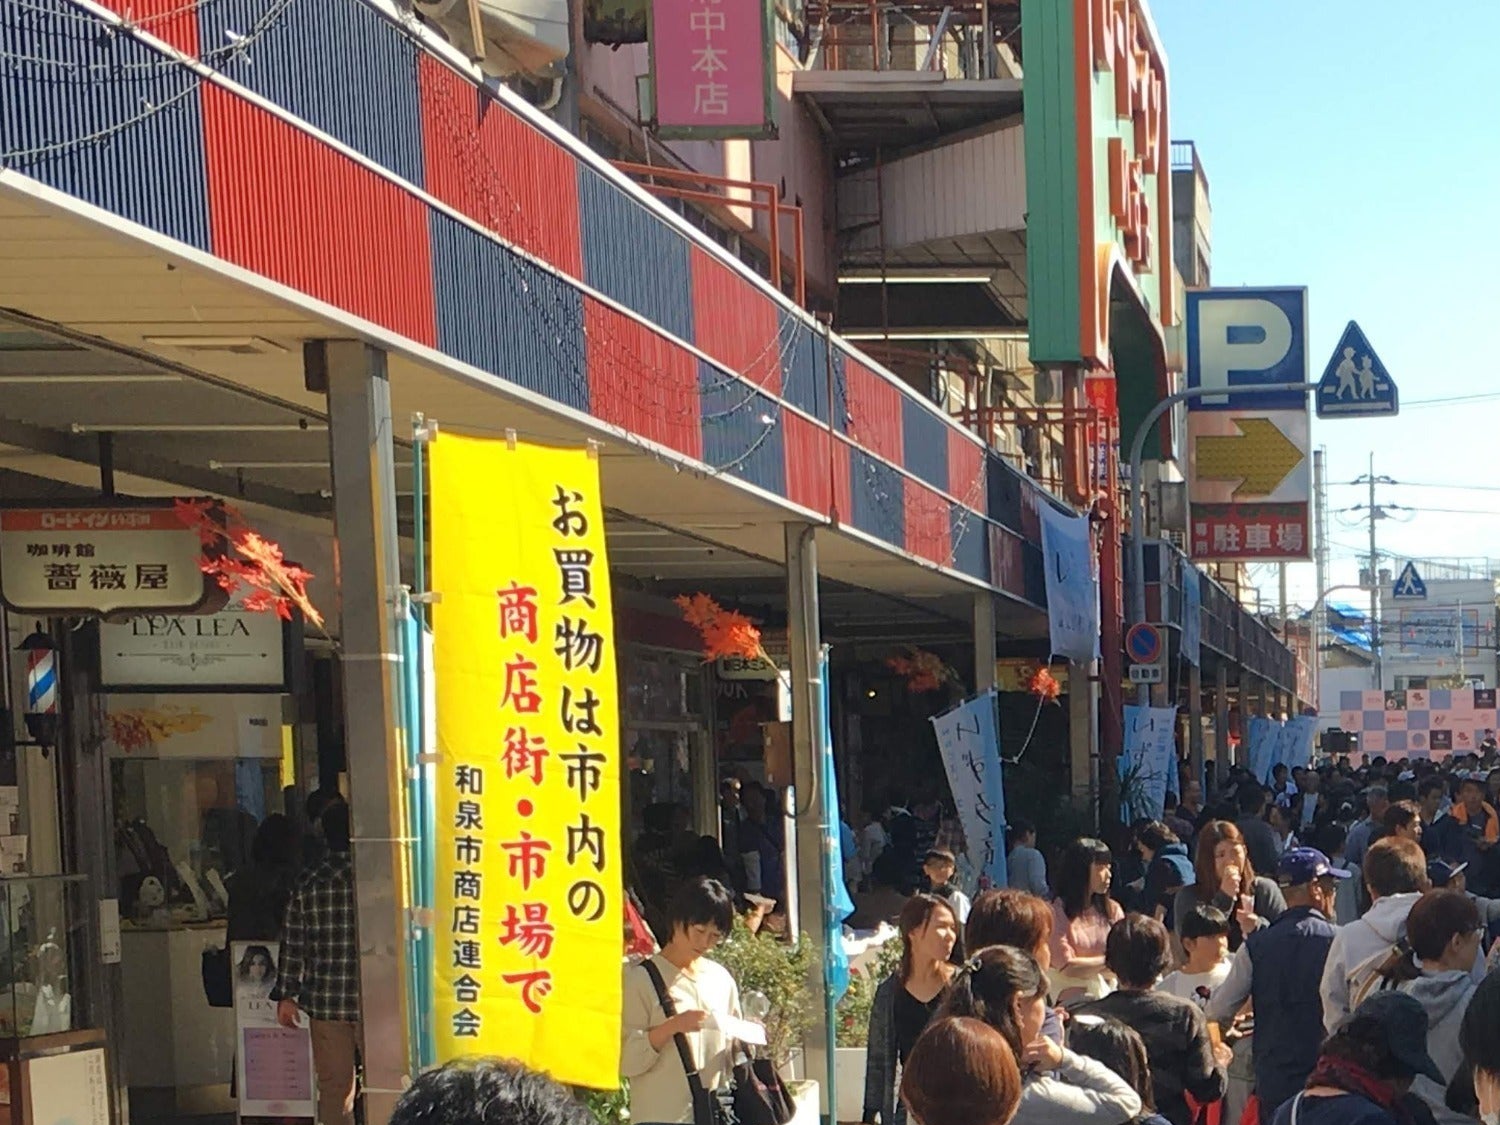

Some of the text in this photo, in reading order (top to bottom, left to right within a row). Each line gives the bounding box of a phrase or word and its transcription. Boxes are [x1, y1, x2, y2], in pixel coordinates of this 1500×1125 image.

[690, 0, 728, 115] 中本店
[1199, 299, 1293, 404] P
[27, 543, 96, 558] 珈琲館
[44, 563, 169, 591] 薔薇屋
[1212, 522, 1304, 553] 駐車場
[196, 617, 250, 637] LEA
[552, 484, 607, 922] お買物は市内の
[496, 581, 556, 1014] 商店街・市場で
[452, 763, 484, 1038] 和泉市商店連合会
